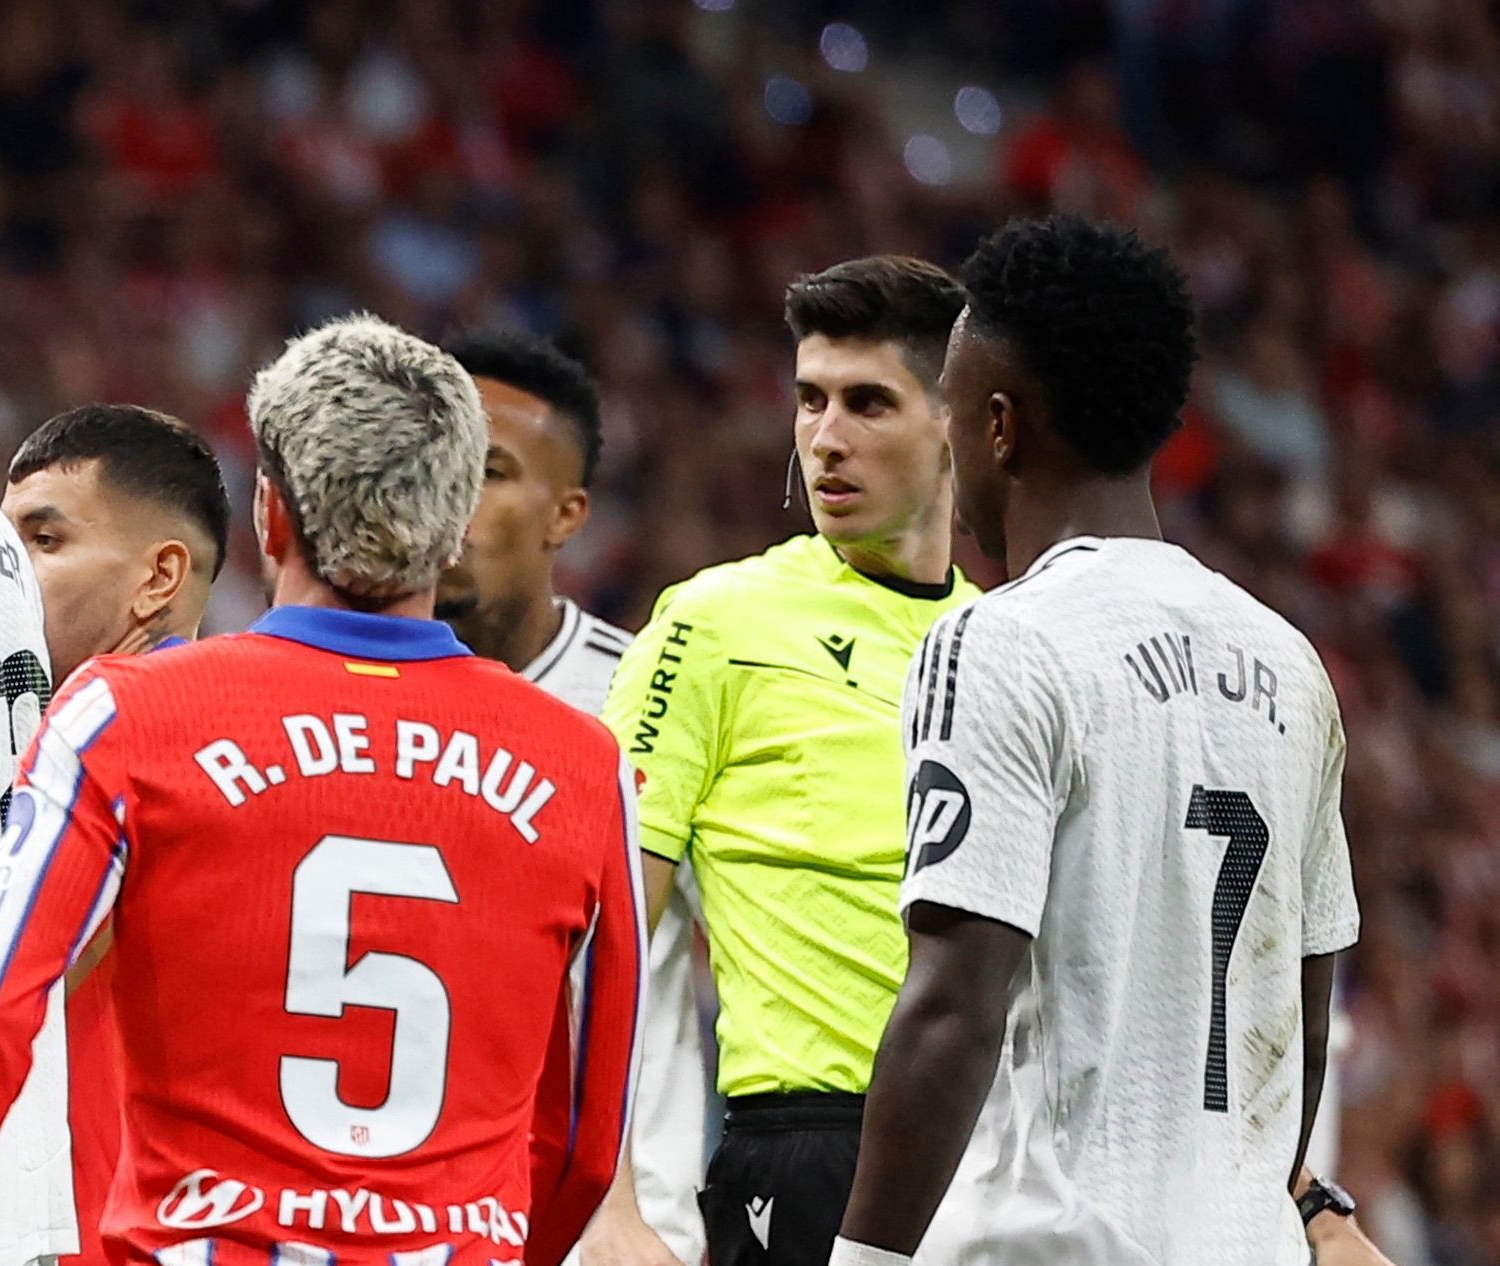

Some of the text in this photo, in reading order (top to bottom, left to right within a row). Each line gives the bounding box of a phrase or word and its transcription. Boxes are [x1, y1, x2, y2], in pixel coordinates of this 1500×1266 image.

[628, 621, 694, 755] WÜRTH
[1216, 641, 1286, 737] JR.
[194, 713, 557, 845] R. DE PAUL
[278, 833, 460, 1160] 5
[1184, 783, 1270, 1112] 7
